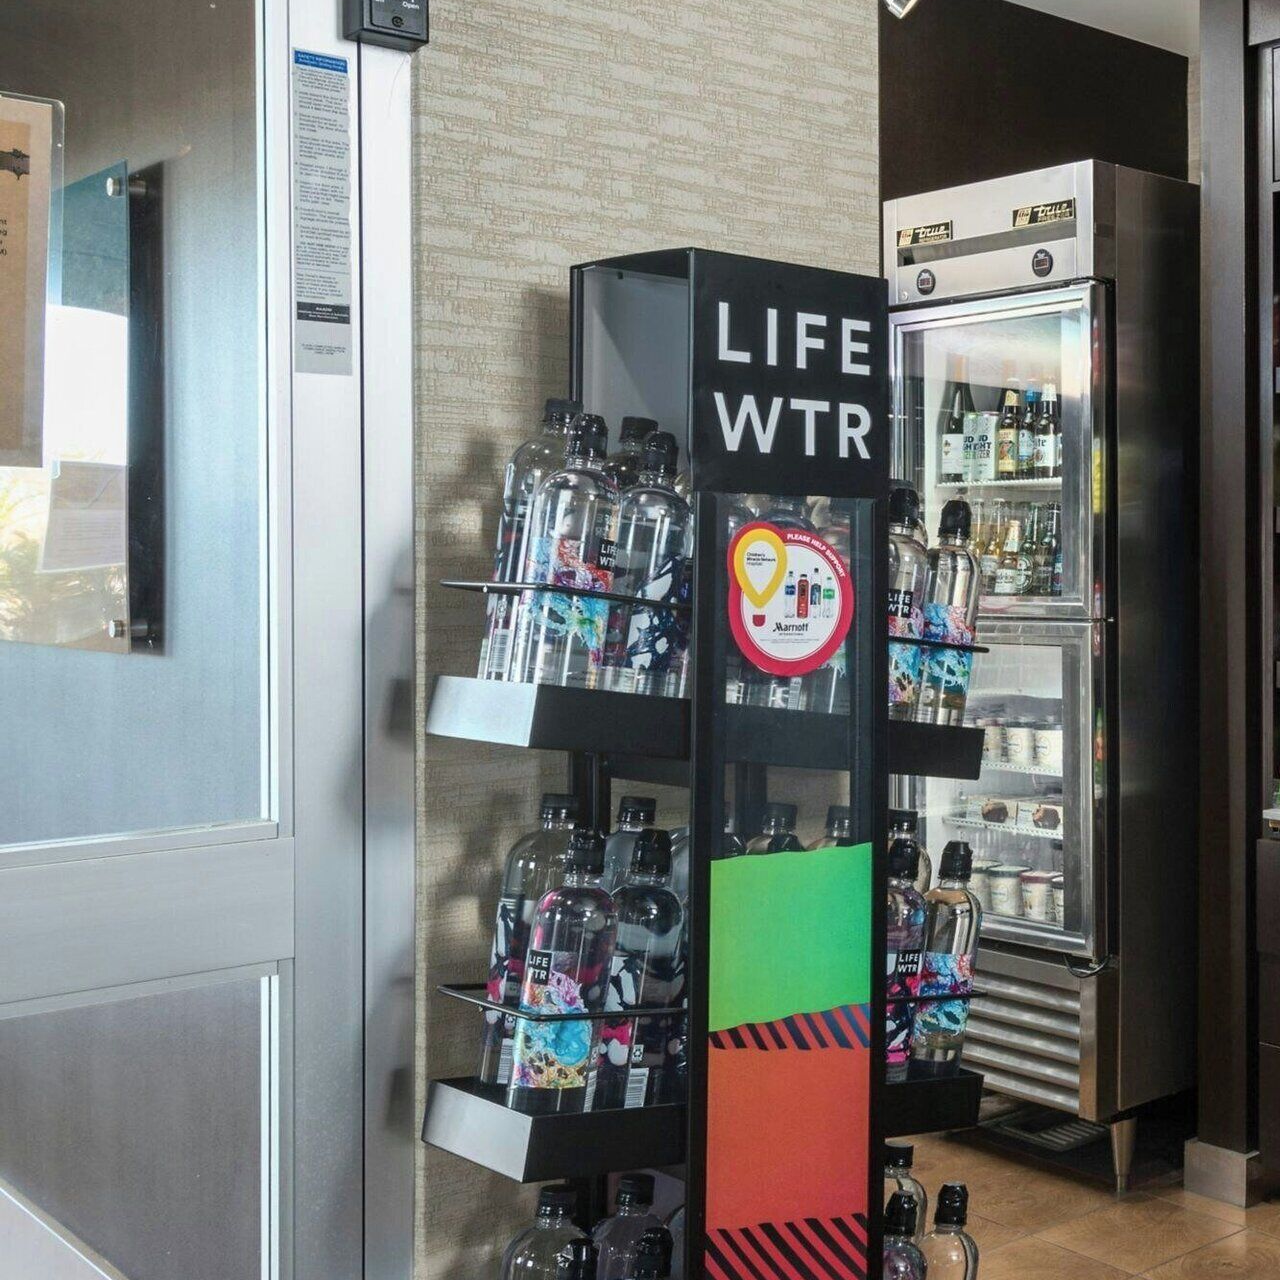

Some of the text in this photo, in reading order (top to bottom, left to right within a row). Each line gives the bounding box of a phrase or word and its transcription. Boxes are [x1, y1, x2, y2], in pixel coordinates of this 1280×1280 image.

[402, 1, 420, 9] Open
[717, 301, 872, 377] LIFE
[714, 391, 872, 460] WTR
[787, 533, 846, 578] PLEASE HELP SUPPORT
[888, 594, 911, 605] LIFE
[773, 622, 809, 632] Marriott
[528, 954, 549, 968] LIFE
[899, 953, 919, 963] LIFE
[897, 963, 918, 973] WTR
